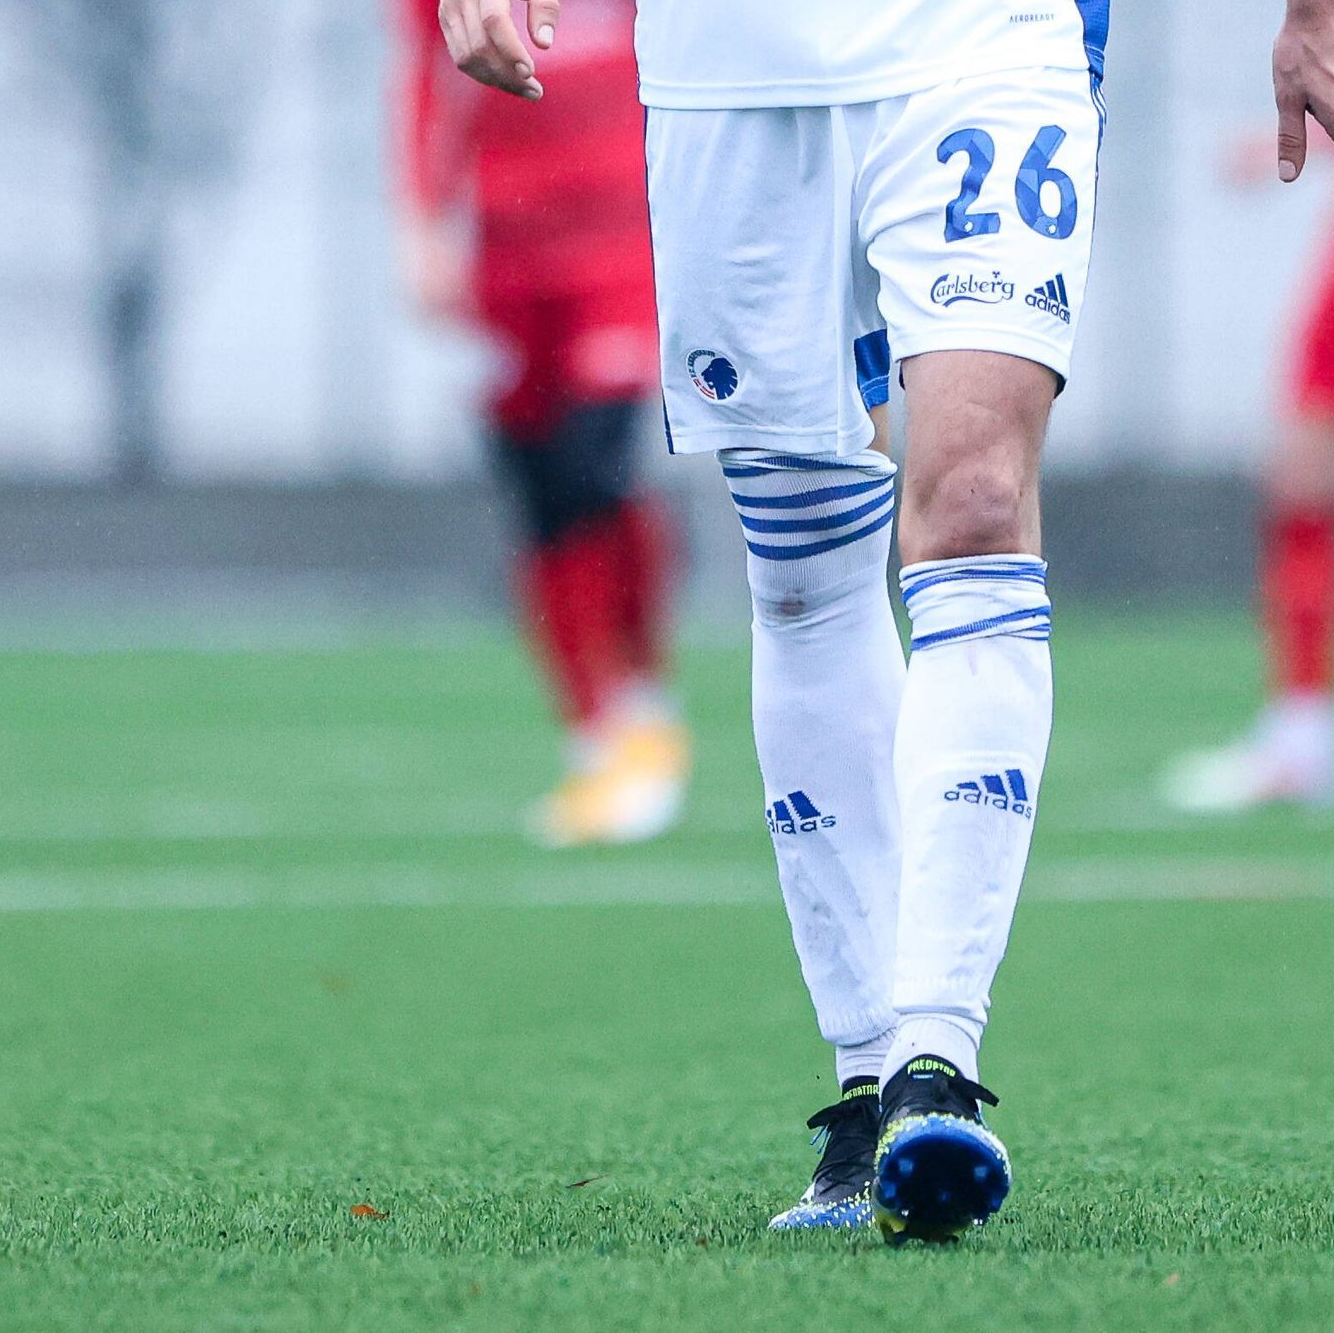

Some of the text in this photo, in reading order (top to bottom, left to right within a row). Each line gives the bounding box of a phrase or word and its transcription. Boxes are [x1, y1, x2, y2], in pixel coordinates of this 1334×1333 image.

[936, 123, 1078, 244] 26
[930, 273, 1015, 304] Carlsberg
[944, 789, 1033, 819] adidas
[907, 1058, 957, 1078] PREDATOR
